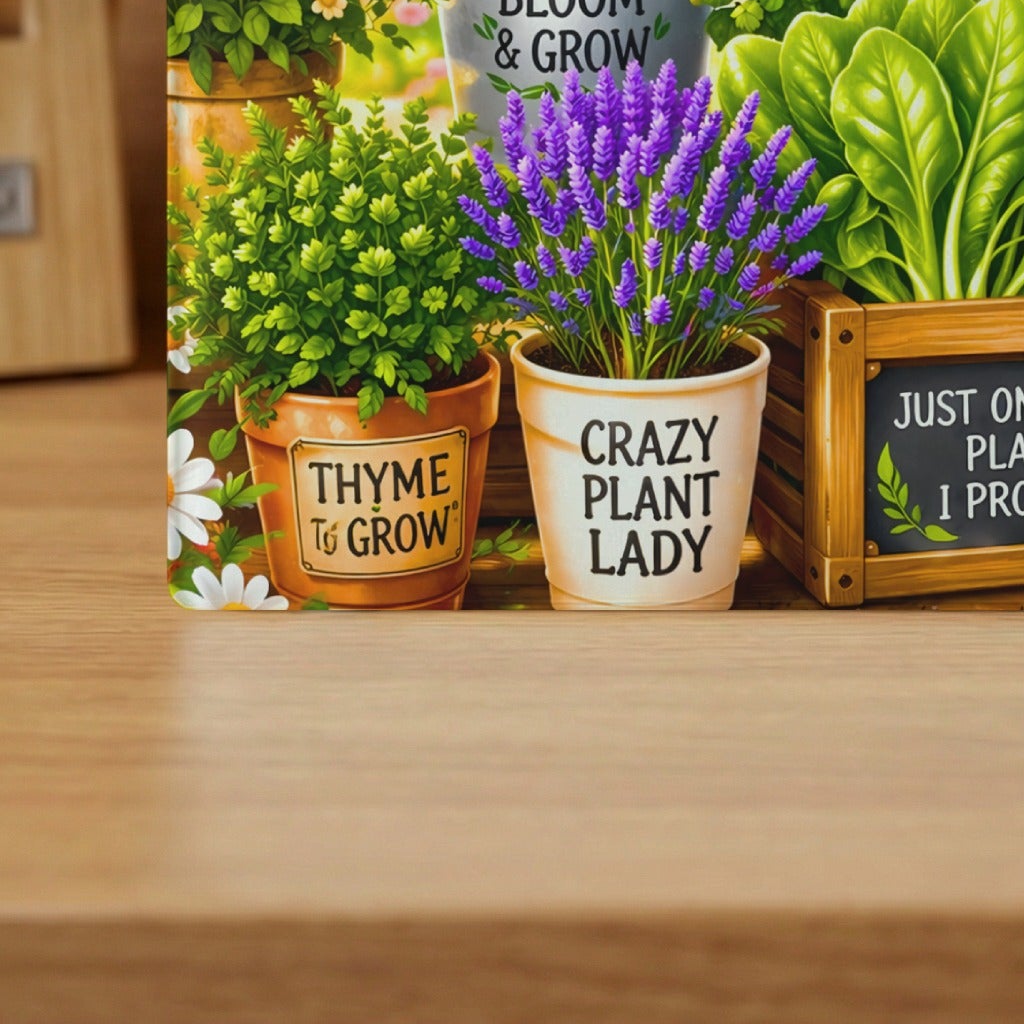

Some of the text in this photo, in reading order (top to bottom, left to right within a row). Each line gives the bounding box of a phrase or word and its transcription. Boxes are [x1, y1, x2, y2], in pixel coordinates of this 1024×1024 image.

[494, 26, 651, 74] & GROW
[893, 388, 978, 430] JUST
[580, 414, 719, 466] CRAZY
[308, 452, 451, 506] THYME
[582, 471, 720, 522] PLANT
[938, 483, 951, 521] I
[346, 505, 451, 558] GROW
[589, 525, 714, 578] LADY
